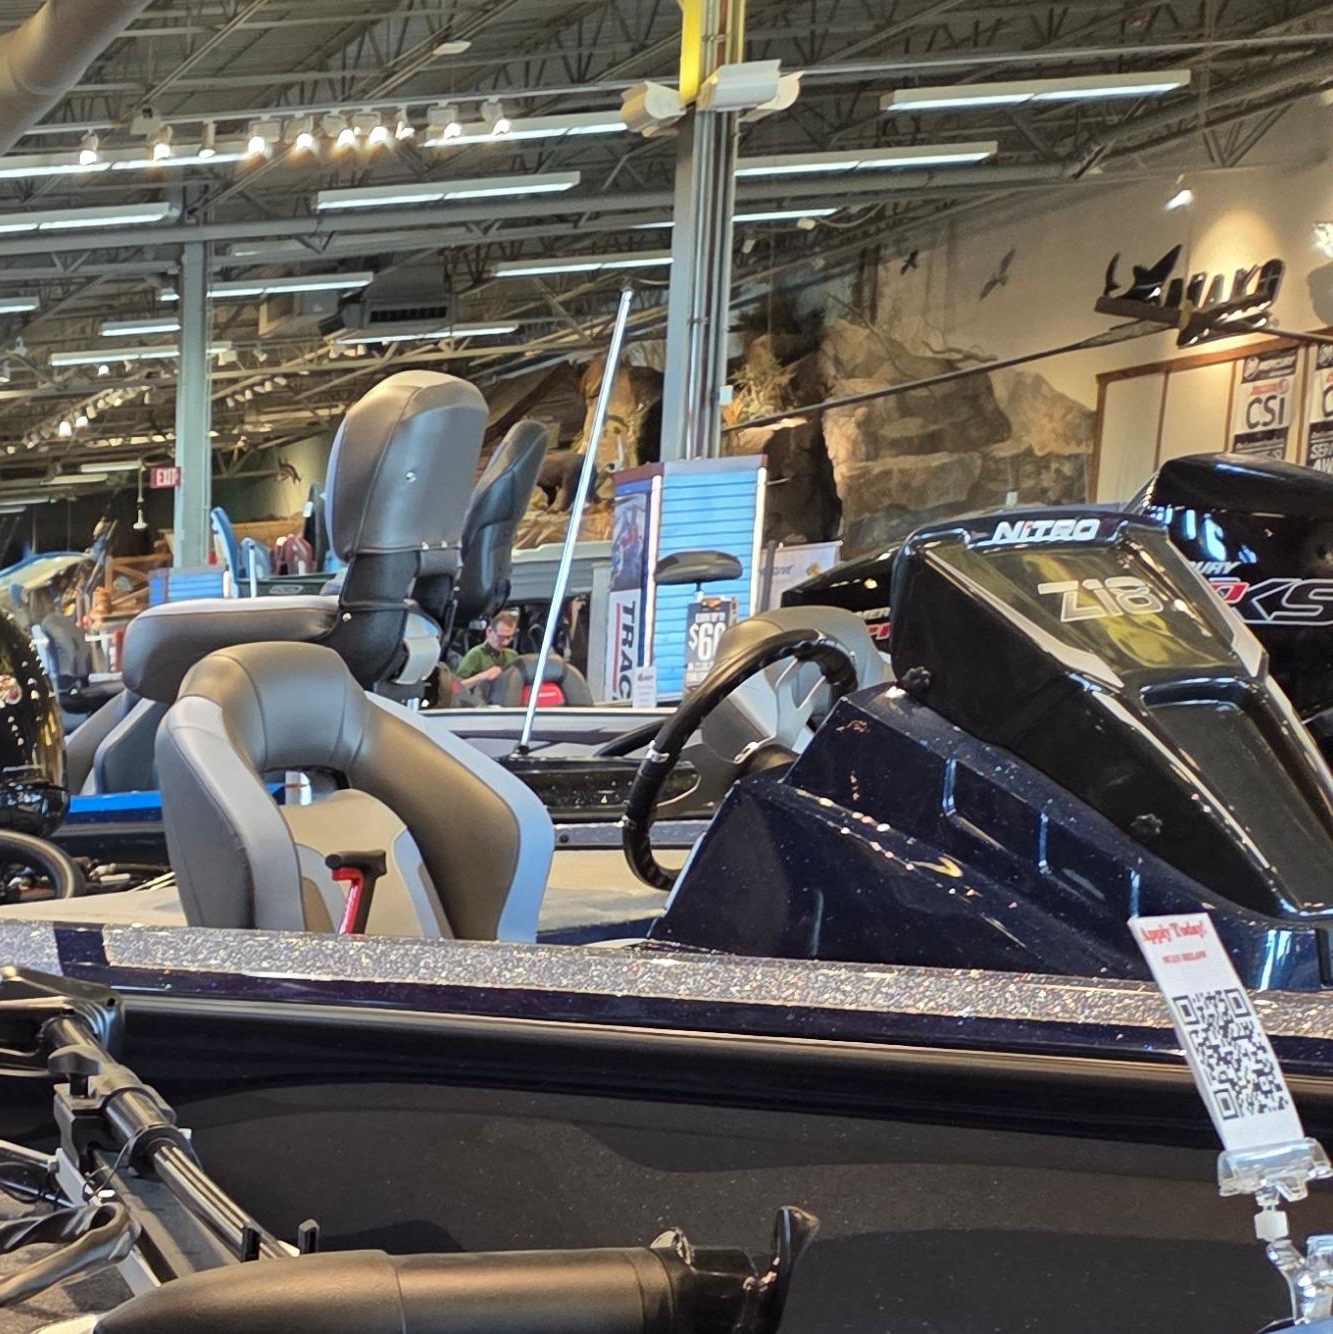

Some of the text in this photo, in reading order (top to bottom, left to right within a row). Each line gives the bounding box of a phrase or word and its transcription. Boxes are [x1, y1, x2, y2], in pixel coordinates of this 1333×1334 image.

[1246, 395, 1285, 429] CSI
[991, 518, 1101, 542] NITRO
[617, 600, 636, 700] TRAC
